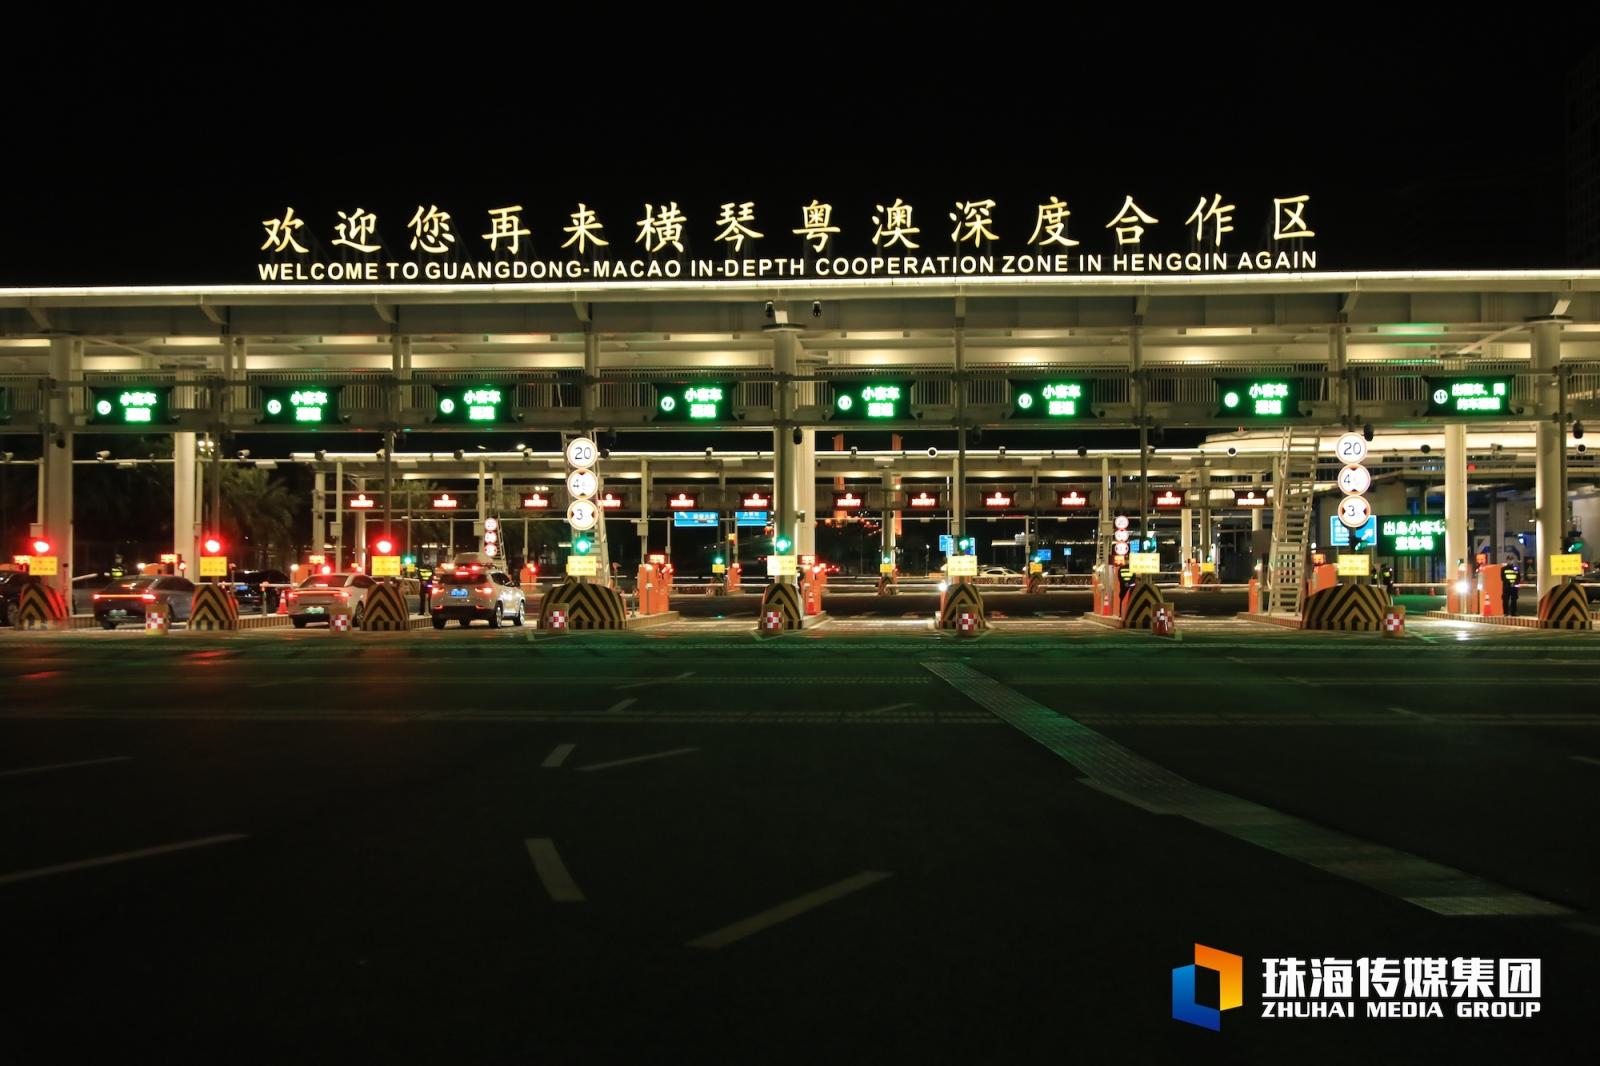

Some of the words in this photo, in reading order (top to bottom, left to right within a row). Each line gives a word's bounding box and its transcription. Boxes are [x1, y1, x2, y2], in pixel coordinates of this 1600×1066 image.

[261, 194, 1315, 254] 欢迎您再来横琴粤澳深度合作区
[259, 263, 378, 280] WELCOME
[386, 262, 418, 279] TO
[425, 260, 680, 279] GUANGDONG-MACAO
[692, 259, 804, 276] IN-DEPTH
[816, 256, 993, 275] COOPERATION
[1002, 255, 1067, 273] ZONE
[1080, 255, 1101, 271] IN
[1114, 253, 1226, 271] HENGQIN
[1238, 251, 1316, 269] AGAIN
[574, 446, 592, 460] 20
[1343, 442, 1362, 456] 20
